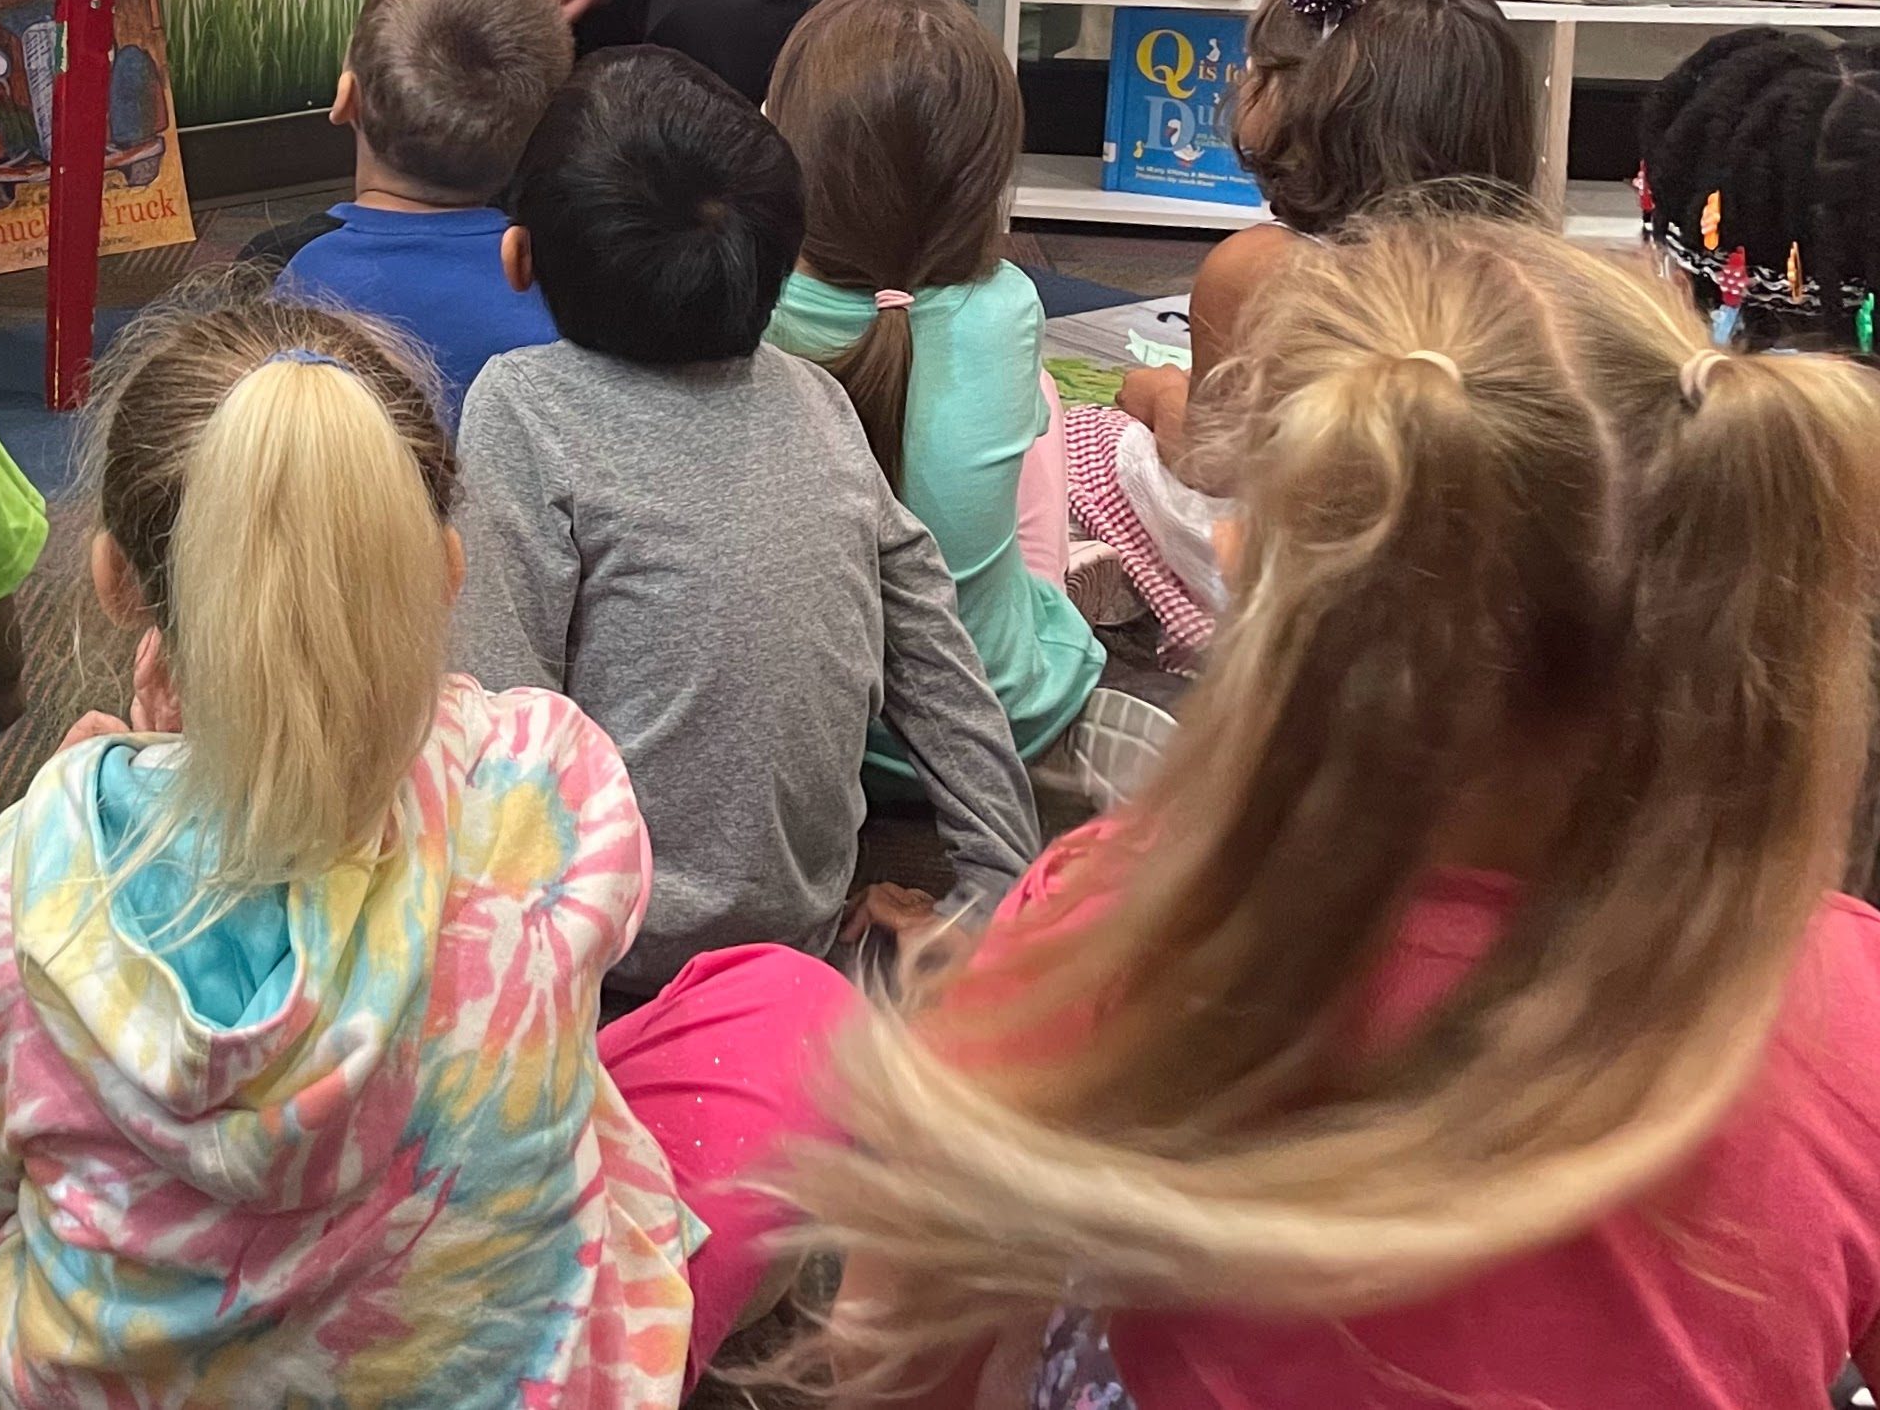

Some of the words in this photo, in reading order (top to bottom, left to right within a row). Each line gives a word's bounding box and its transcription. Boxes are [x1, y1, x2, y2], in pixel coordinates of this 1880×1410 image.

[1136, 29, 1197, 99] Q
[1197, 60, 1217, 82] is
[1225, 62, 1242, 84] fo
